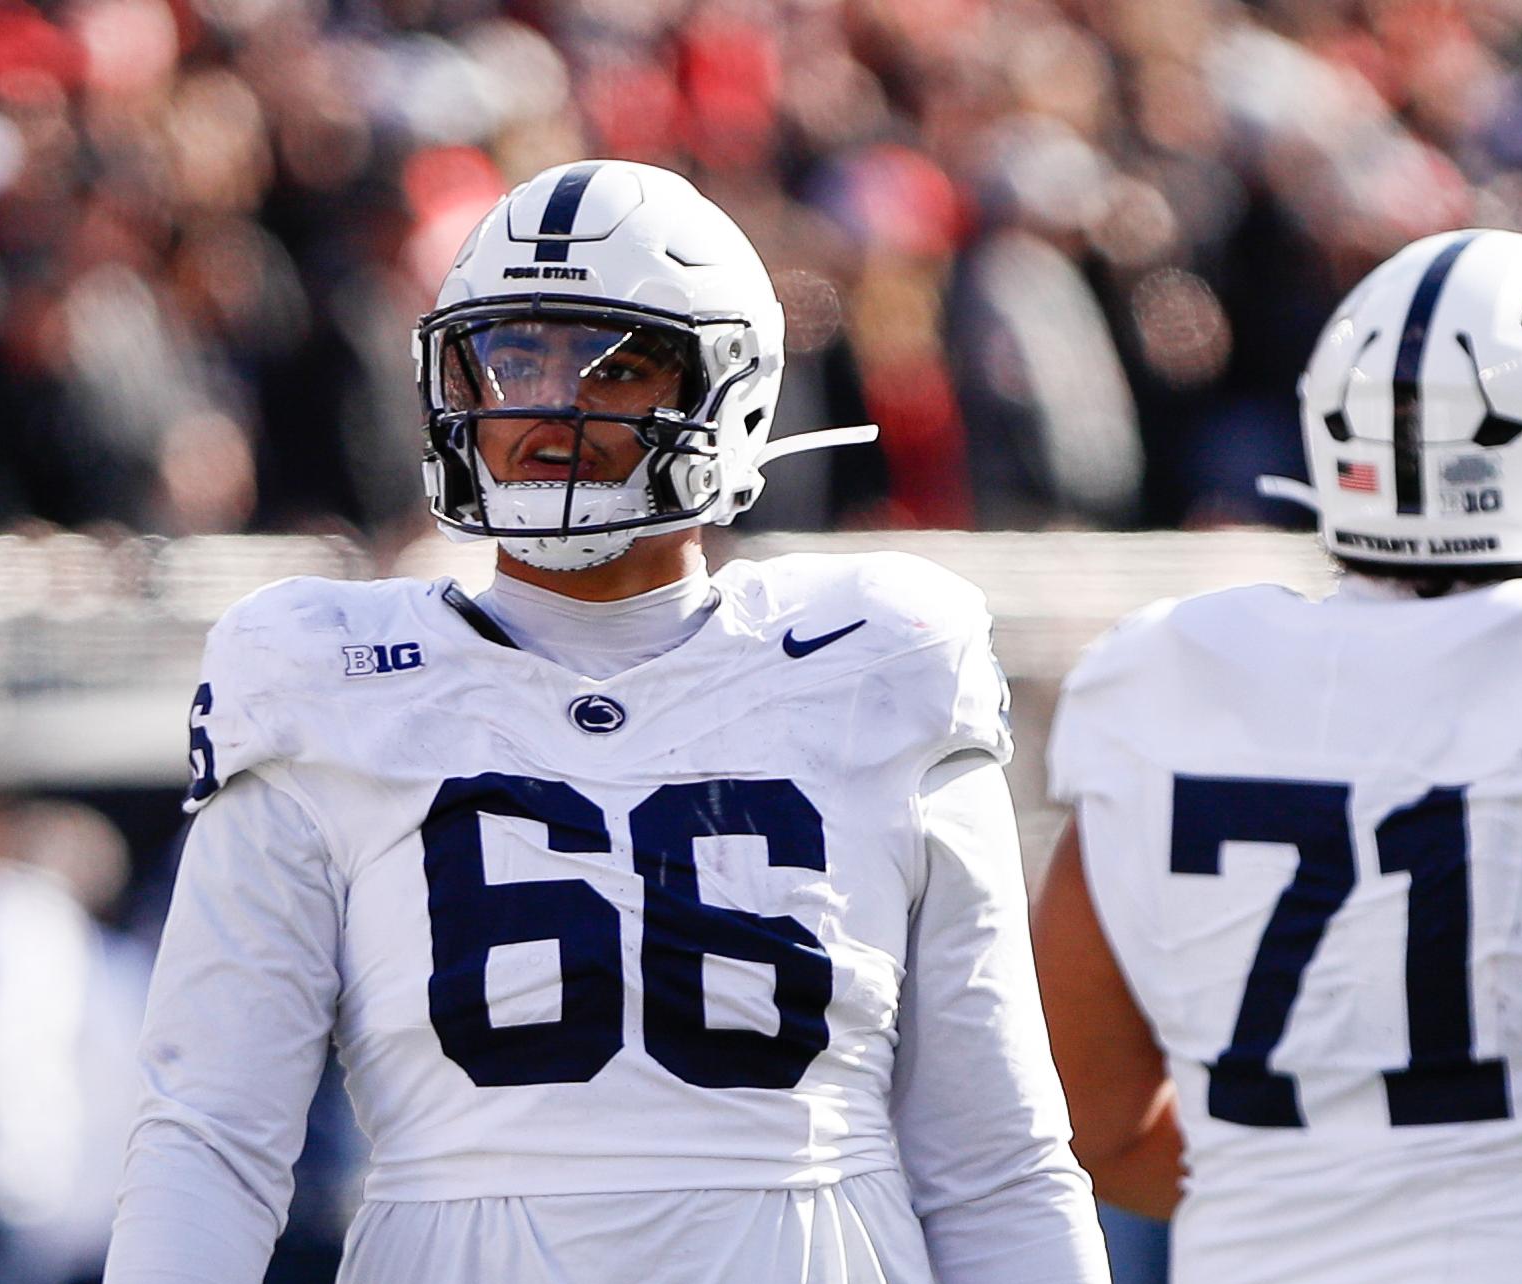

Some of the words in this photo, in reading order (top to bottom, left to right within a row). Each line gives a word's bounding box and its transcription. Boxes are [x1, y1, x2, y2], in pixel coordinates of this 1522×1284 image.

[542, 266, 588, 280] STATE
[421, 772, 832, 1088] 66
[1171, 774, 1512, 1127] 71
